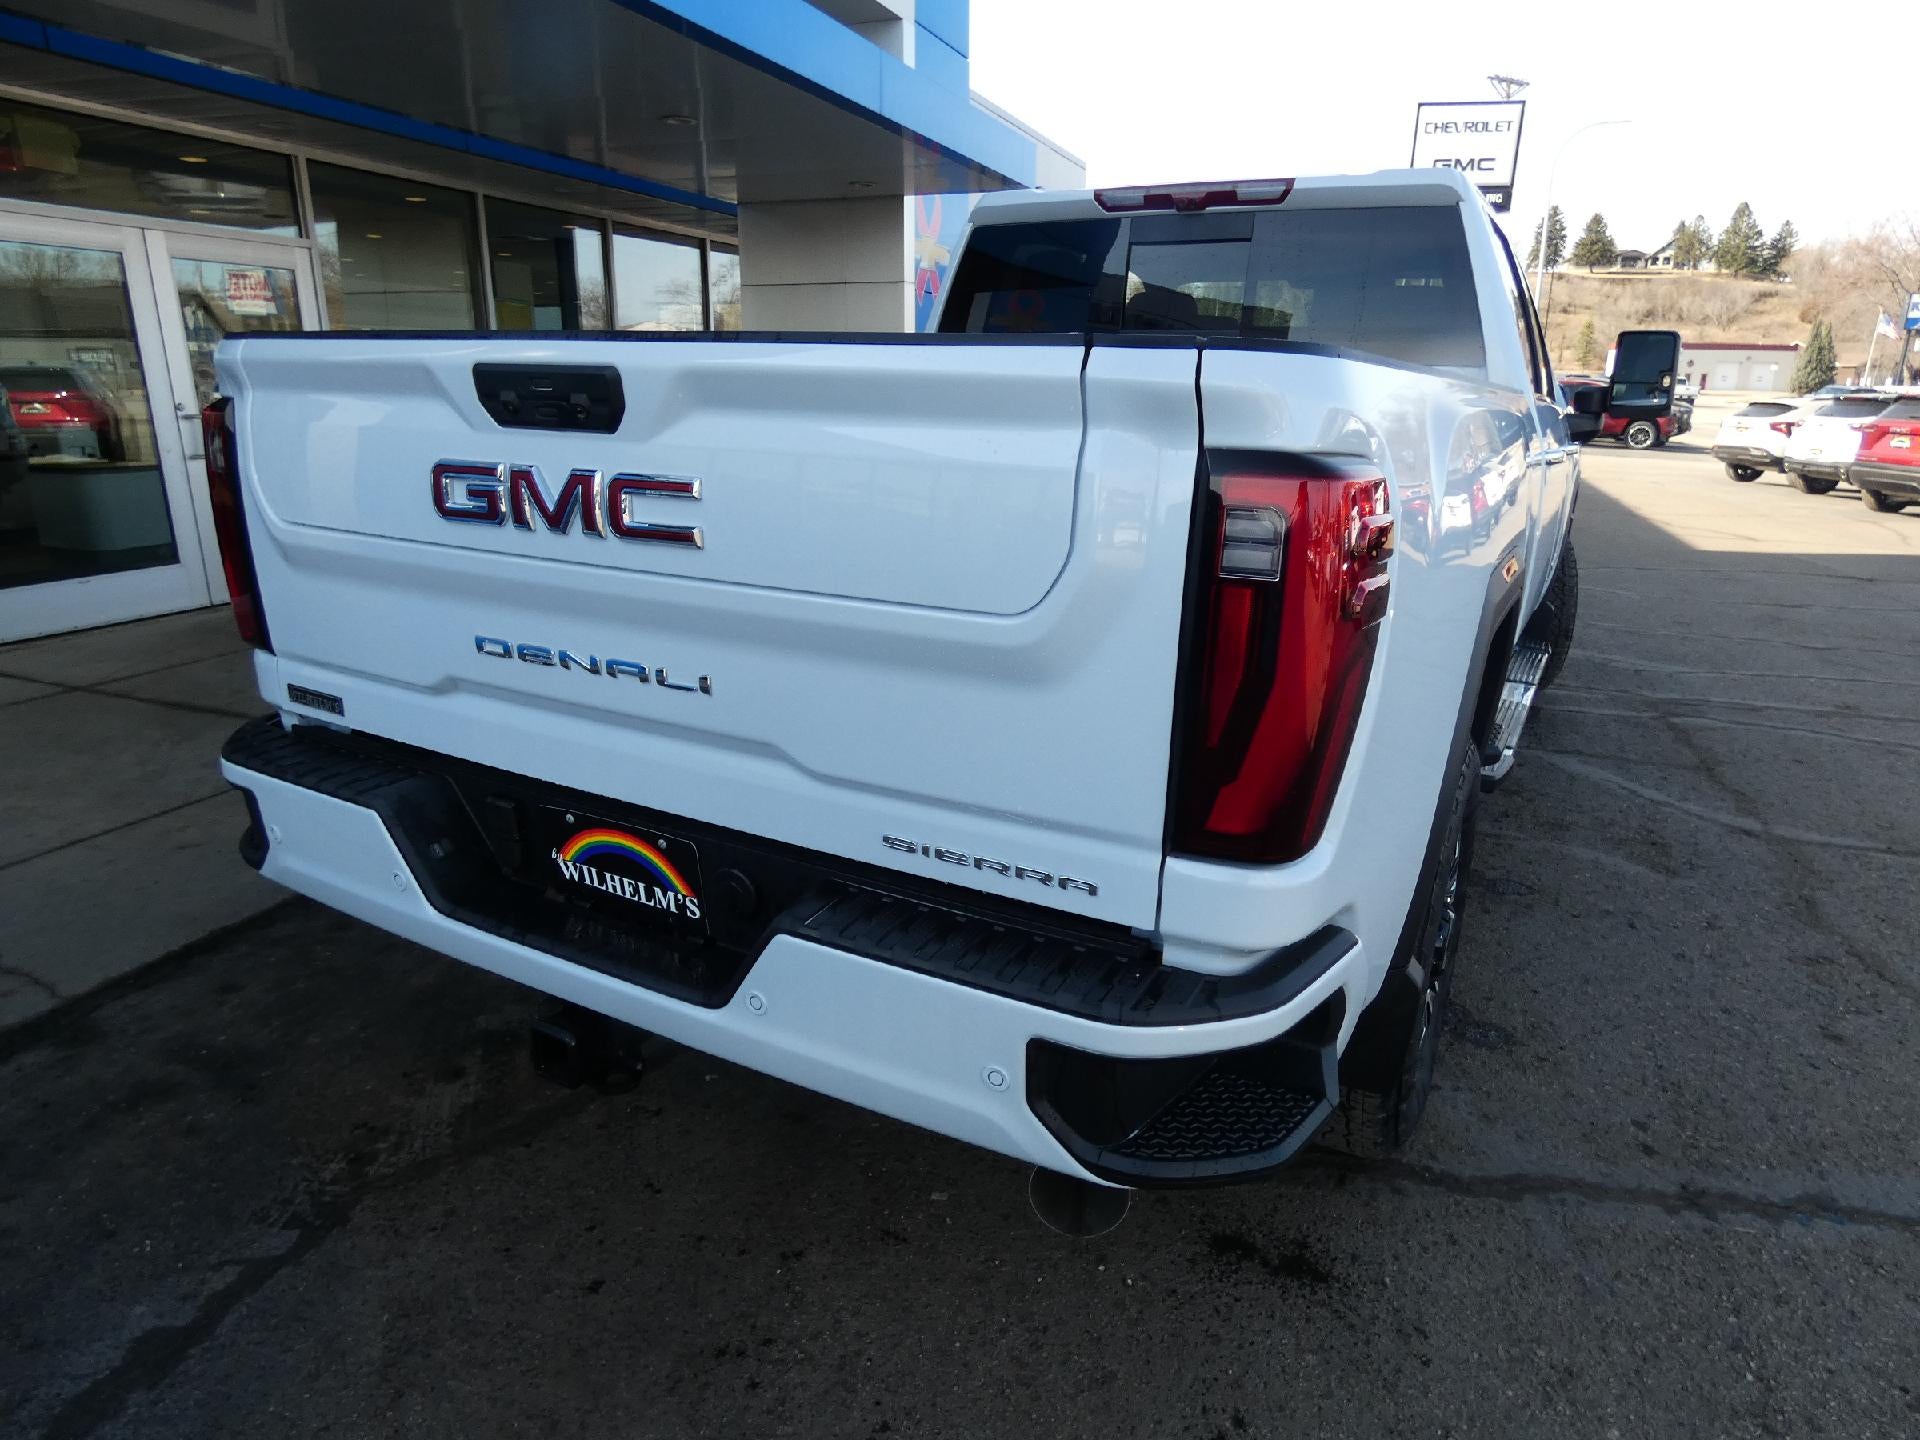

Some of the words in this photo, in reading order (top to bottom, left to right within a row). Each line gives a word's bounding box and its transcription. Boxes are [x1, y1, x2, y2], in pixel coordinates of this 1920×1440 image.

[1425, 121, 1513, 134] CHEVROLET
[1434, 158, 1495, 171] GMC
[431, 459, 704, 550] GMC
[474, 634, 712, 696] DENALI
[560, 861, 701, 919] WILHELM'S
[882, 833, 1099, 897] SIERRA
